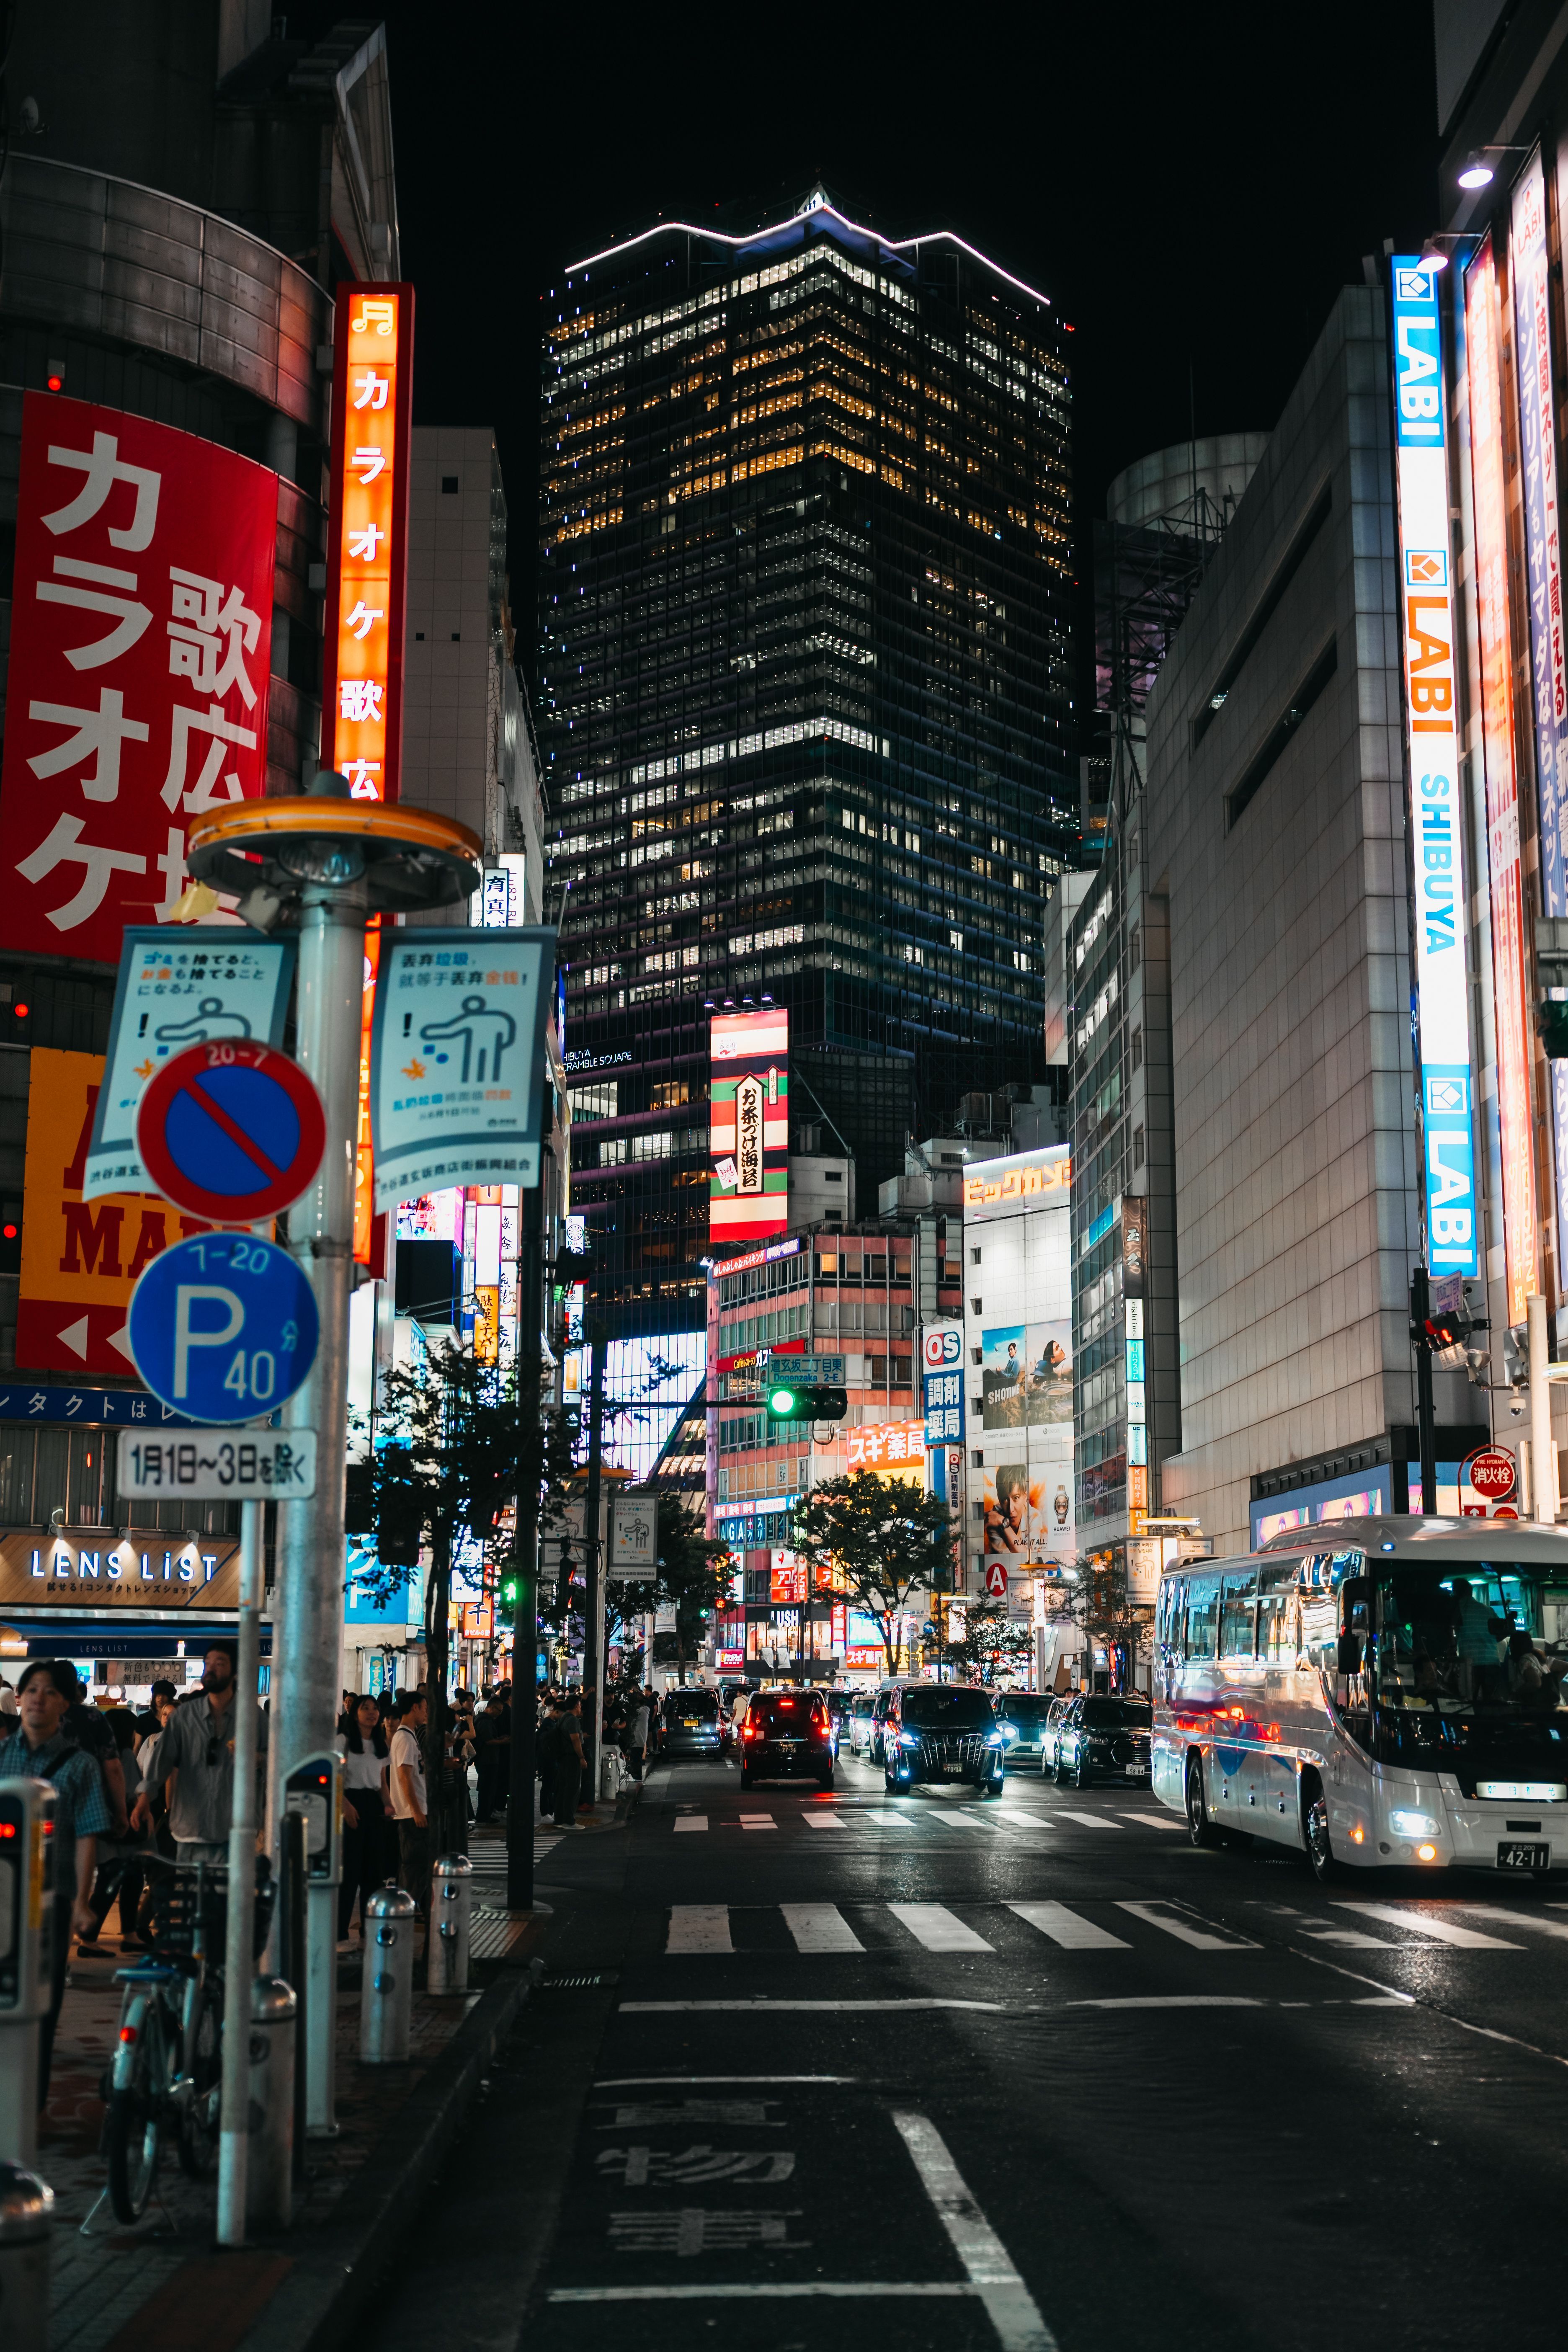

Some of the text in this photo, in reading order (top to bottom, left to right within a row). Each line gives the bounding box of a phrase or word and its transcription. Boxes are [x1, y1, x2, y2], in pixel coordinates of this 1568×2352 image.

[1397, 315, 1439, 436] LABI
[1408, 596, 1454, 733] LABI
[16, 431, 162, 932] カラオケ
[1421, 774, 1455, 956] SHIBUYA
[207, 1046, 269, 1068] 20-7
[562, 1051, 632, 1072] CRAMBLE SQUARE
[563, 1049, 591, 1062] HIBUYA
[741, 1088, 759, 1188] お茶づけ海苔
[963, 1158, 1071, 1207] ビックカメ
[1426, 1130, 1473, 1264] LABI
[188, 1241, 271, 1274] 7-20
[173, 1284, 245, 1400] P
[480, 1295, 493, 1358] 駄菓子バー
[926, 1332, 959, 1364] OS
[223, 1351, 275, 1400] 40
[771, 1358, 842, 1372] 道玄坂二丁目東
[774, 1373, 818, 1384] Dogenzaka
[824, 1373, 841, 1382] 2-E.
[928, 1376, 960, 1407] 調剤
[928, 1408, 960, 1439] 薬局
[848, 1431, 924, 1463] スギ薬局
[779, 1471, 786, 1482] 5F
[1474, 1467, 1511, 1484] 消火栓
[720, 1522, 744, 1541] AGA
[32, 1550, 123, 1579] LENS
[990, 1567, 1005, 1591] A
[784, 1590, 791, 1599] 3F
[833, 1604, 844, 1640] ギ薬局
[124, 1661, 150, 1673] 新色も
[1506, 1851, 1544, 1866] 42-11
